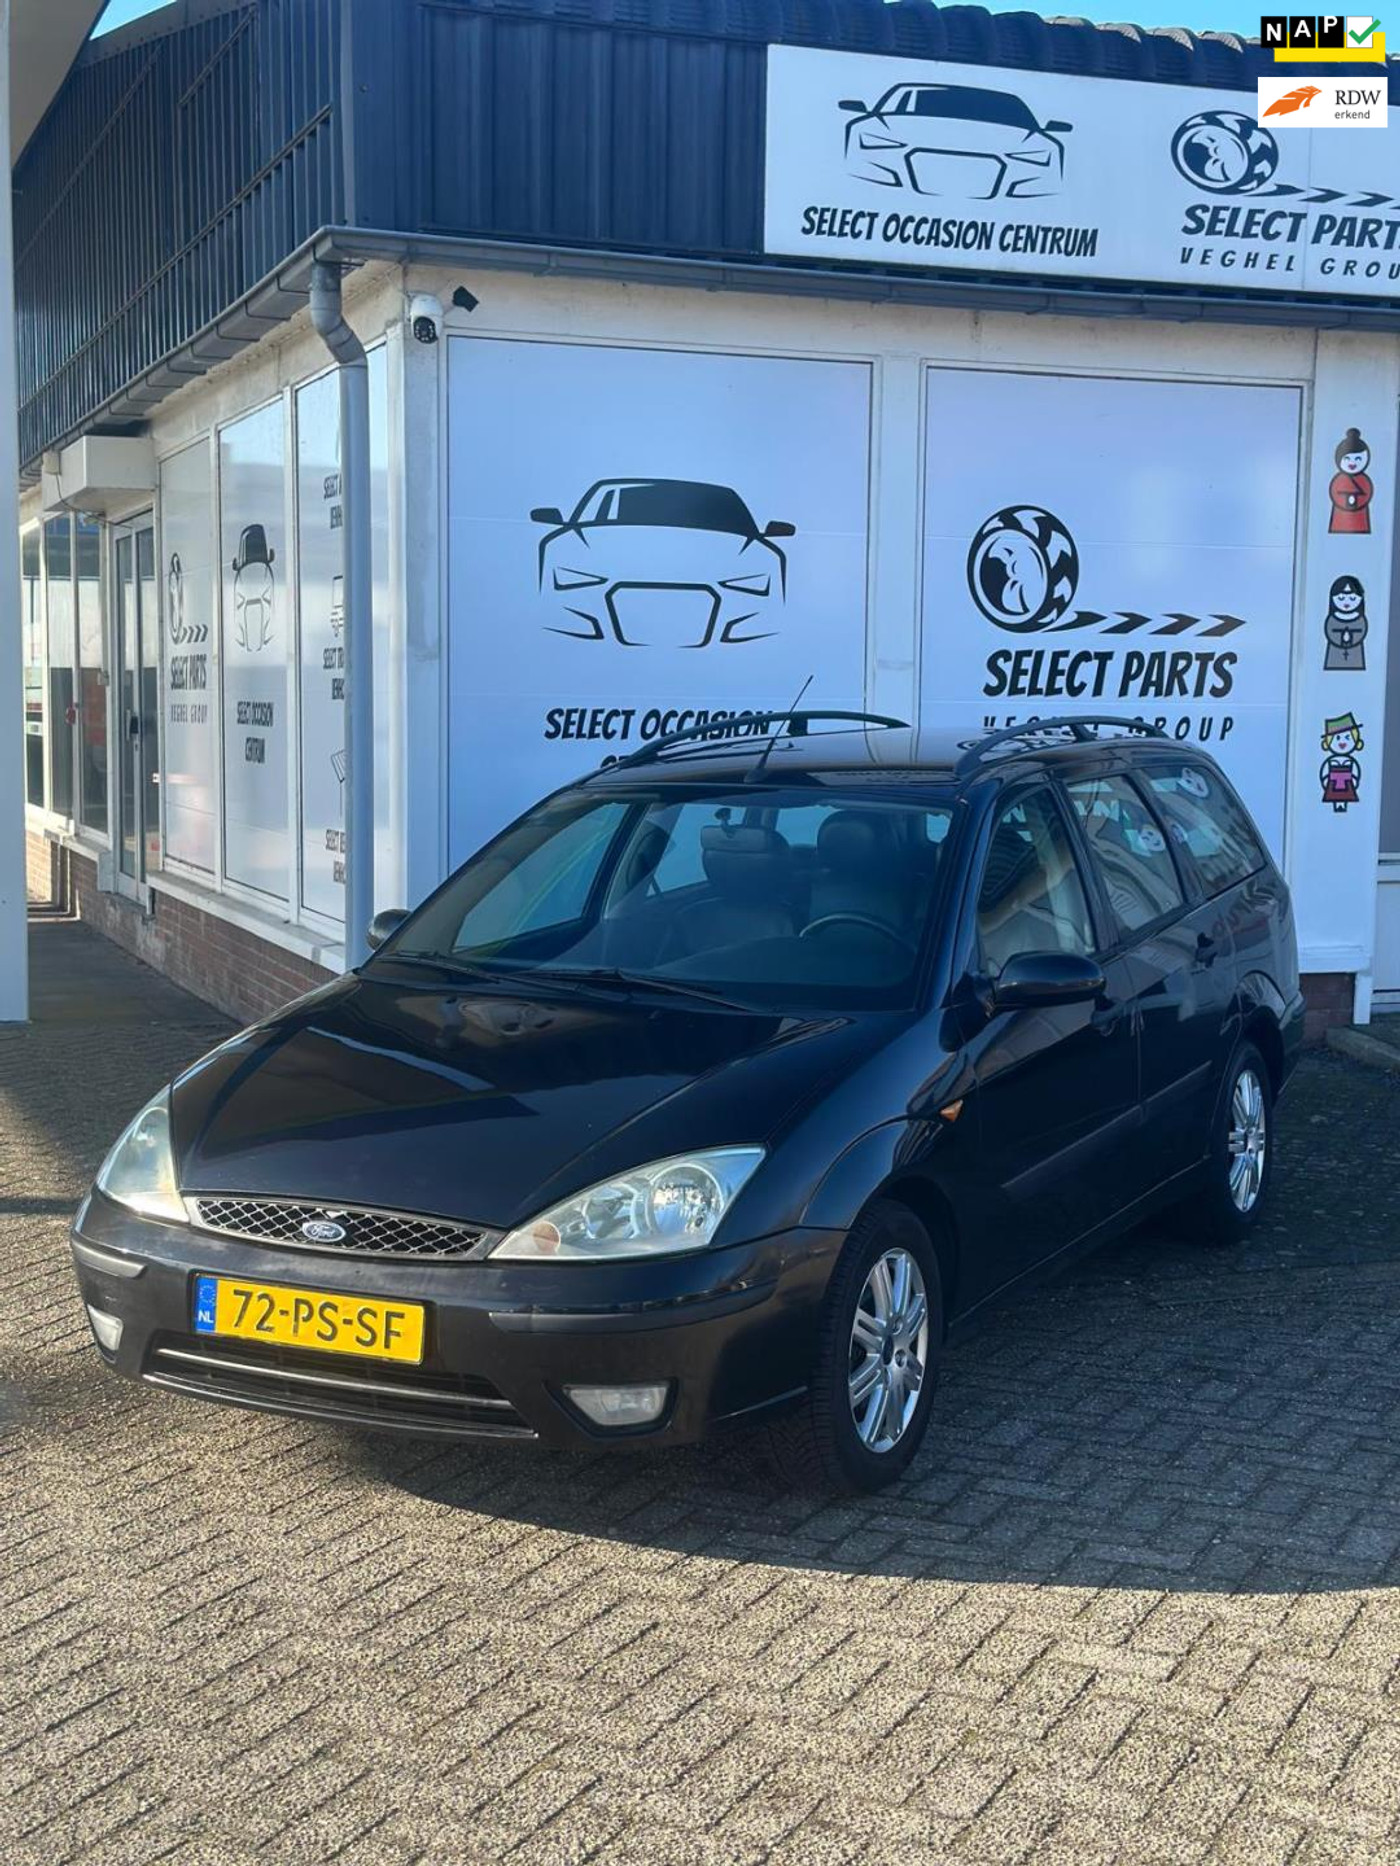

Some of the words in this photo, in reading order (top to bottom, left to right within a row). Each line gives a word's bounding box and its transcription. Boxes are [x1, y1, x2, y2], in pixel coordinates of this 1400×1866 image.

[801, 205, 879, 240] SELECT
[882, 212, 996, 250] OCCASION
[998, 224, 1098, 257] CENTRUM
[1181, 203, 1308, 243] SELECT
[1310, 213, 1400, 250] PART
[1180, 247, 1295, 272] VEGHEL
[983, 649, 1114, 697] SELECT
[1118, 650, 1238, 698] PARTS
[544, 707, 636, 740] SELECT
[198, 1308, 214, 1324] NL
[233, 1290, 405, 1349] 72-PS-SF
